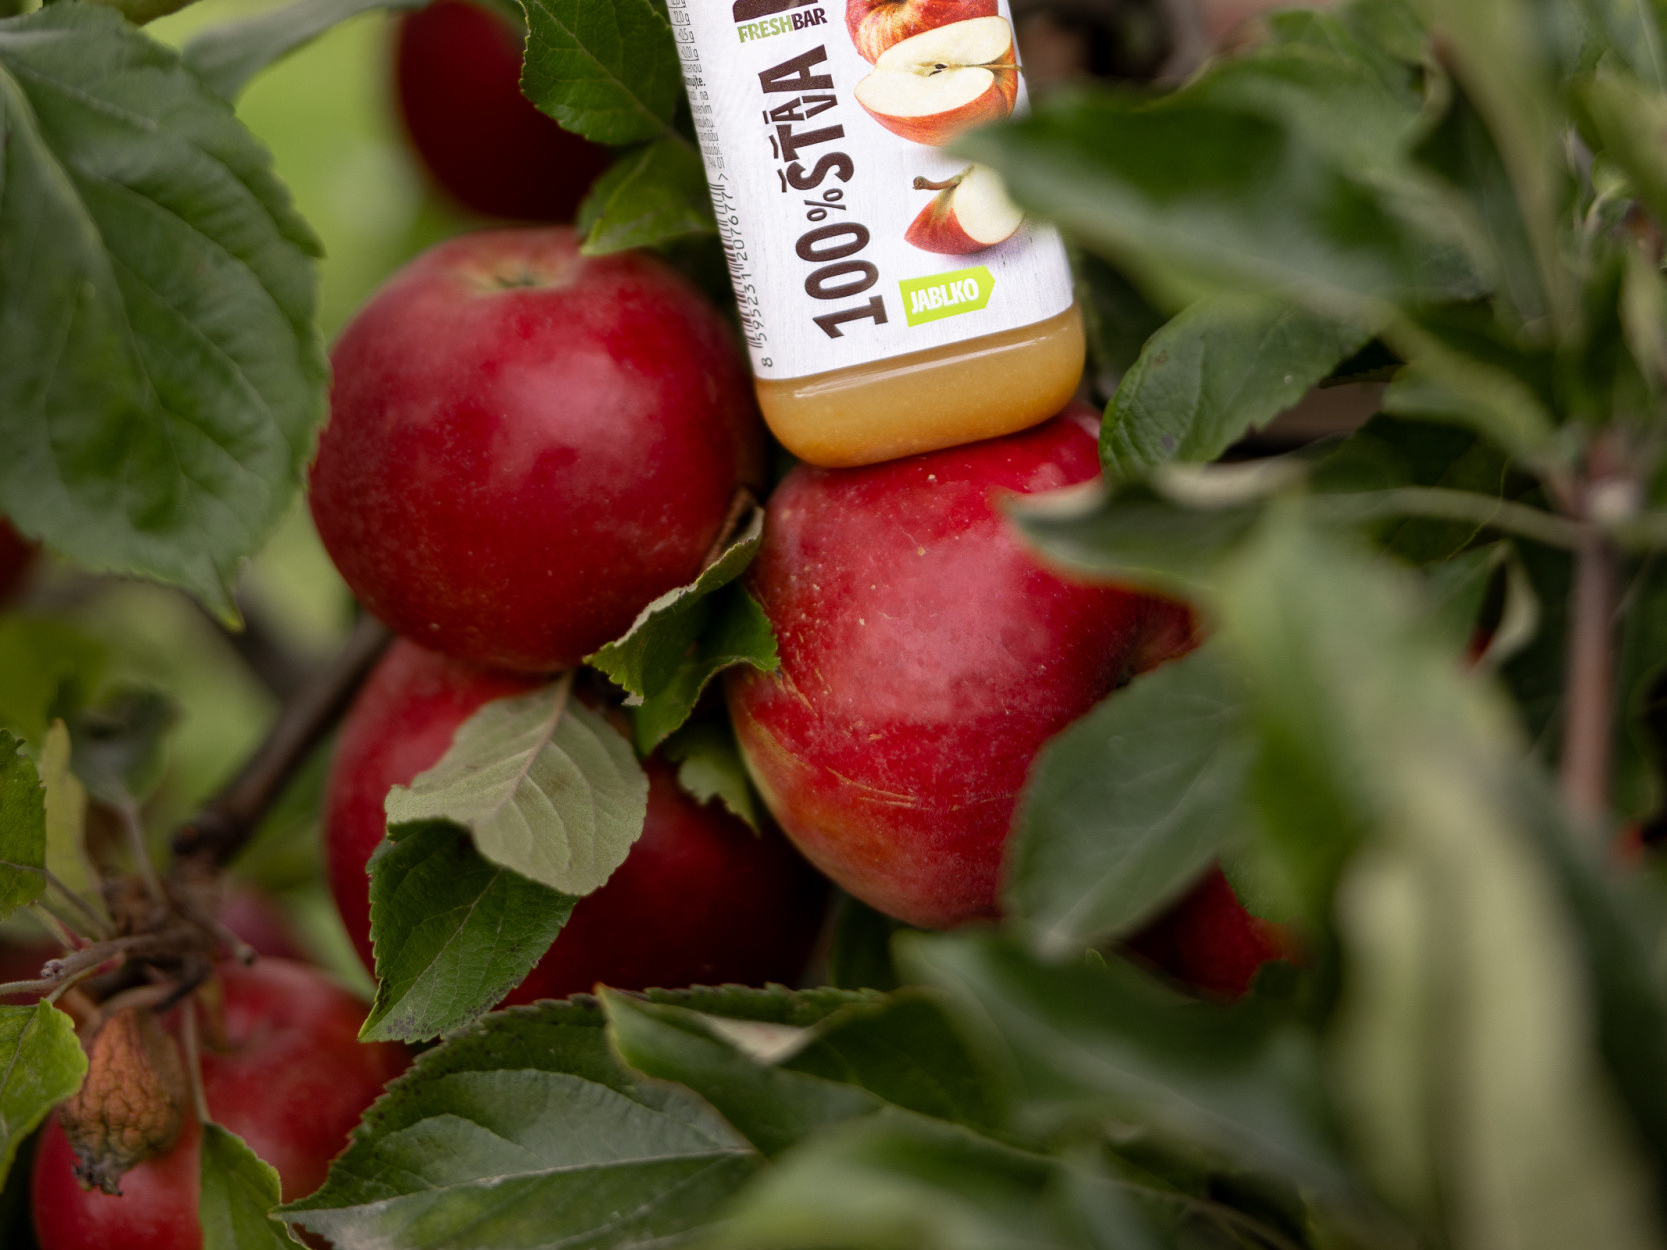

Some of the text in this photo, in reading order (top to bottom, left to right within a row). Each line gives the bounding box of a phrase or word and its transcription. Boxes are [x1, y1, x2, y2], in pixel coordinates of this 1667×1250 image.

[685, 13, 691, 26] g
[689, 30, 695, 43] g
[737, 8, 827, 43] FRESHBAR
[694, 48, 700, 60] g
[758, 44, 888, 339] 100% ŠŤÁVA
[722, 191, 773, 368] 8 595231 207677
[910, 278, 979, 314] JABLKO
